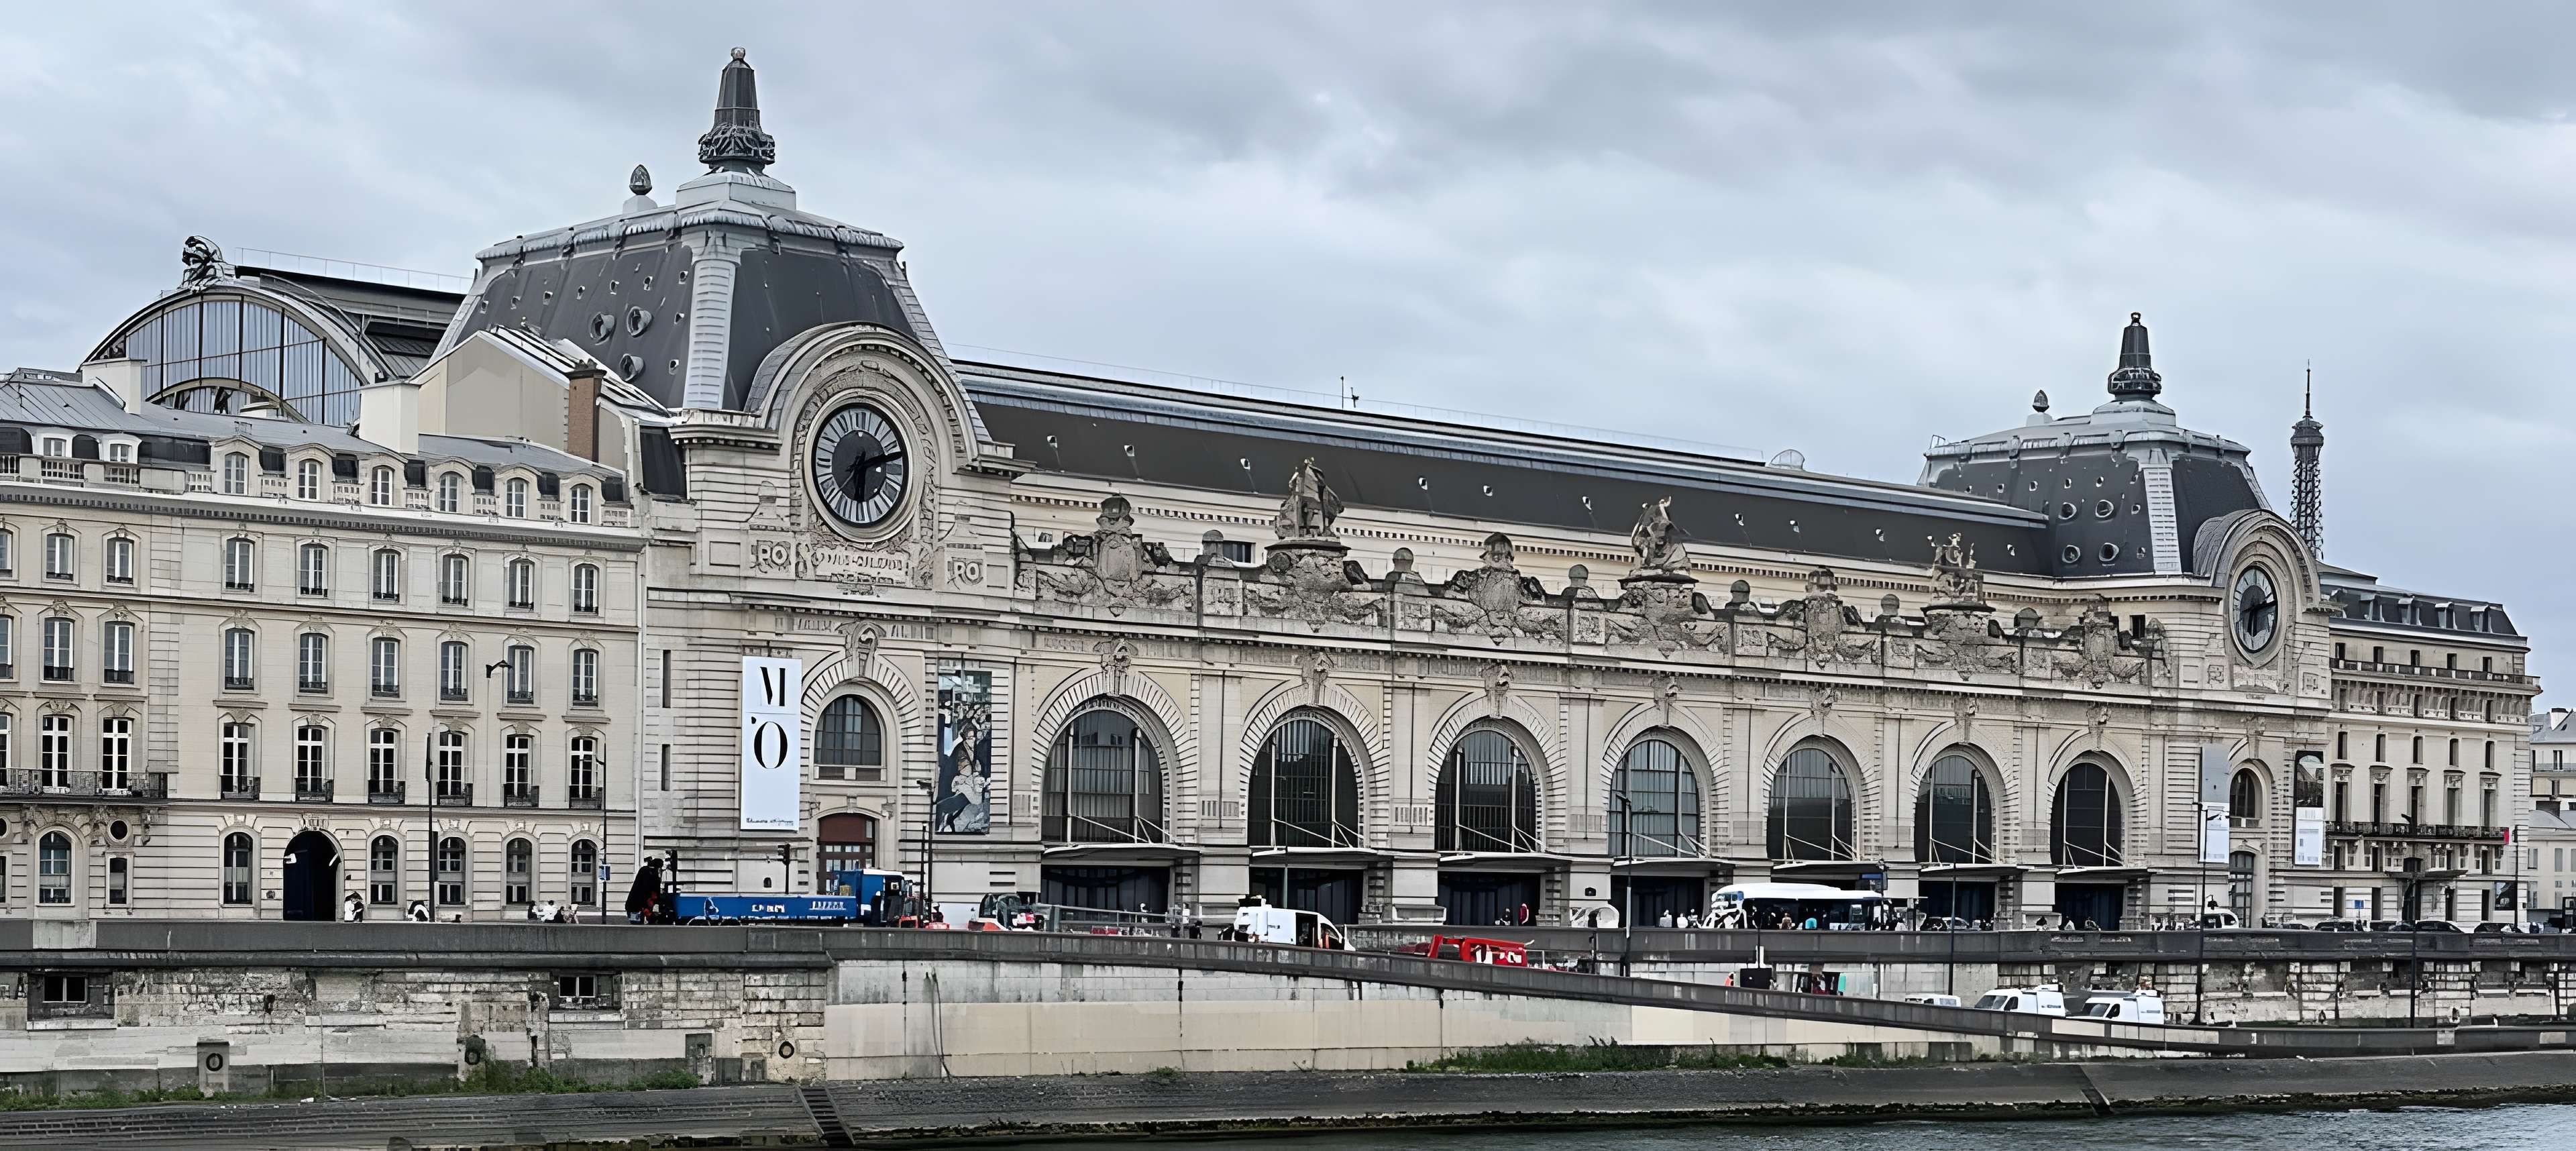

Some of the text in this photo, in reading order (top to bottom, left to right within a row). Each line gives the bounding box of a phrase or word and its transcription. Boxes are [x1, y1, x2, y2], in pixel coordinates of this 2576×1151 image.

[759, 544, 789, 567] PO
[953, 561, 981, 583] PO
[760, 666, 785, 706] M
